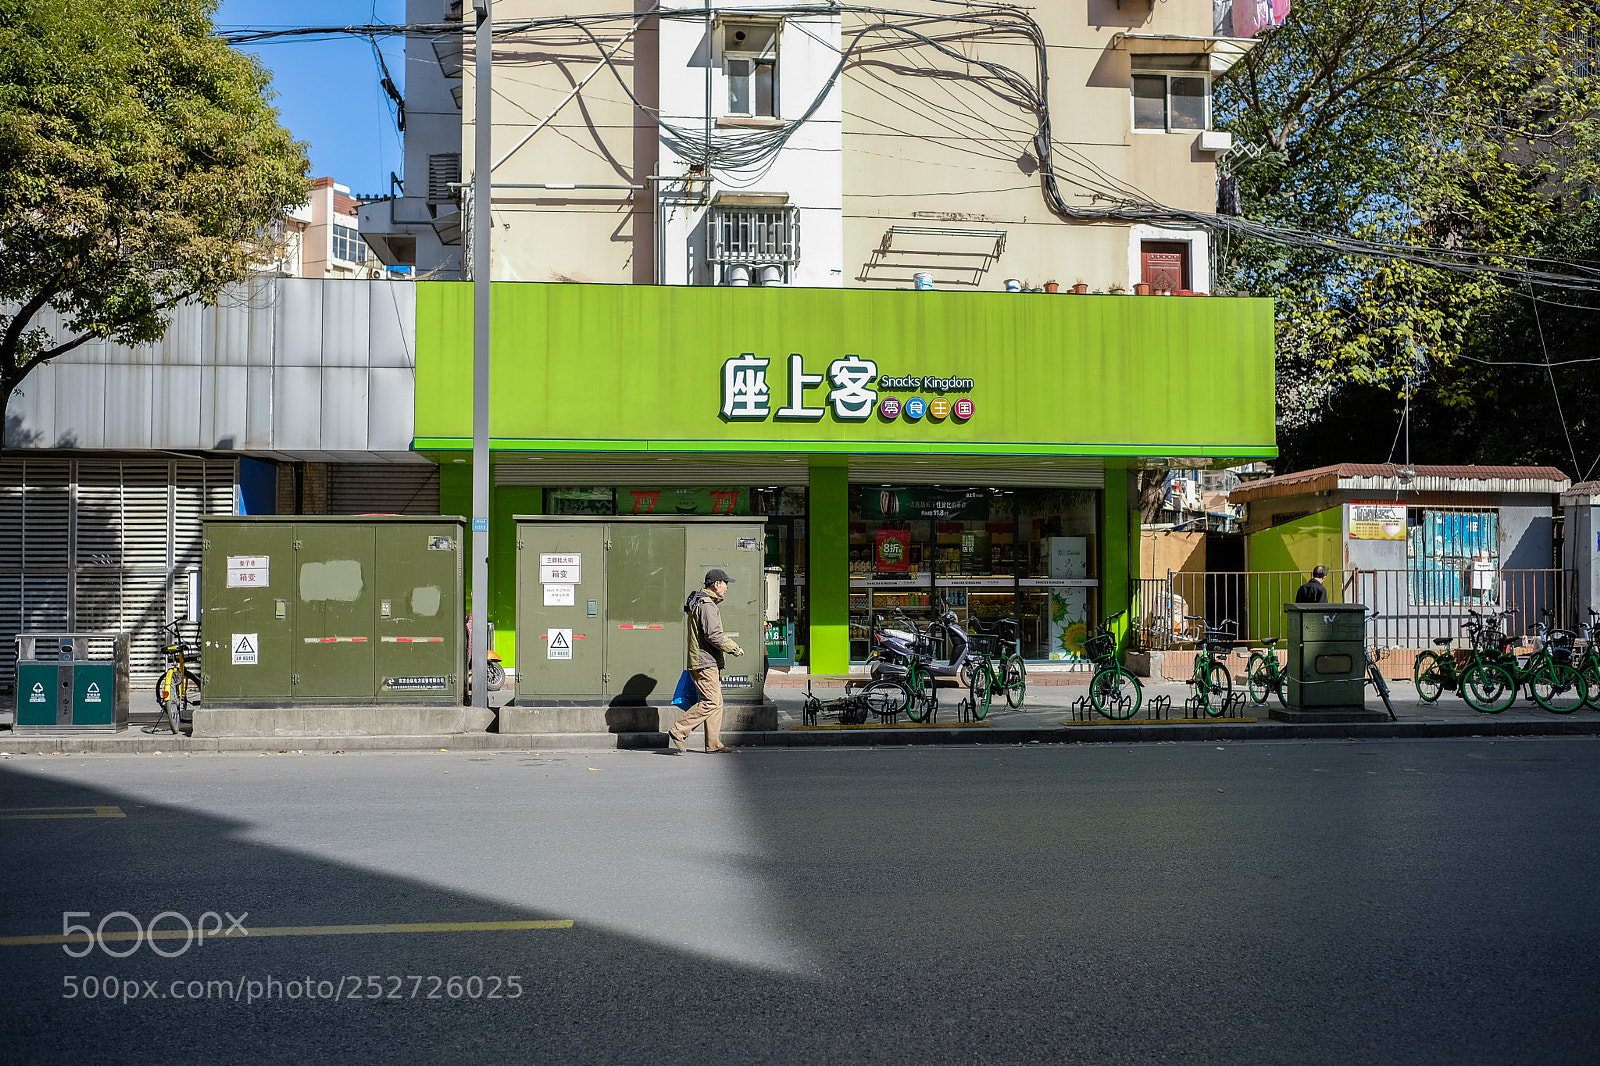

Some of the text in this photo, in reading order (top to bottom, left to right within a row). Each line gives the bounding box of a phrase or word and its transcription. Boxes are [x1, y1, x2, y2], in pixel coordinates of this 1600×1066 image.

[719, 353, 879, 420] 座上客
[880, 374, 975, 391] Snacks Kingdom
[881, 397, 976, 419] 零食王国
[240, 573, 256, 582] 箱变
[551, 569, 568, 578] 箱变
